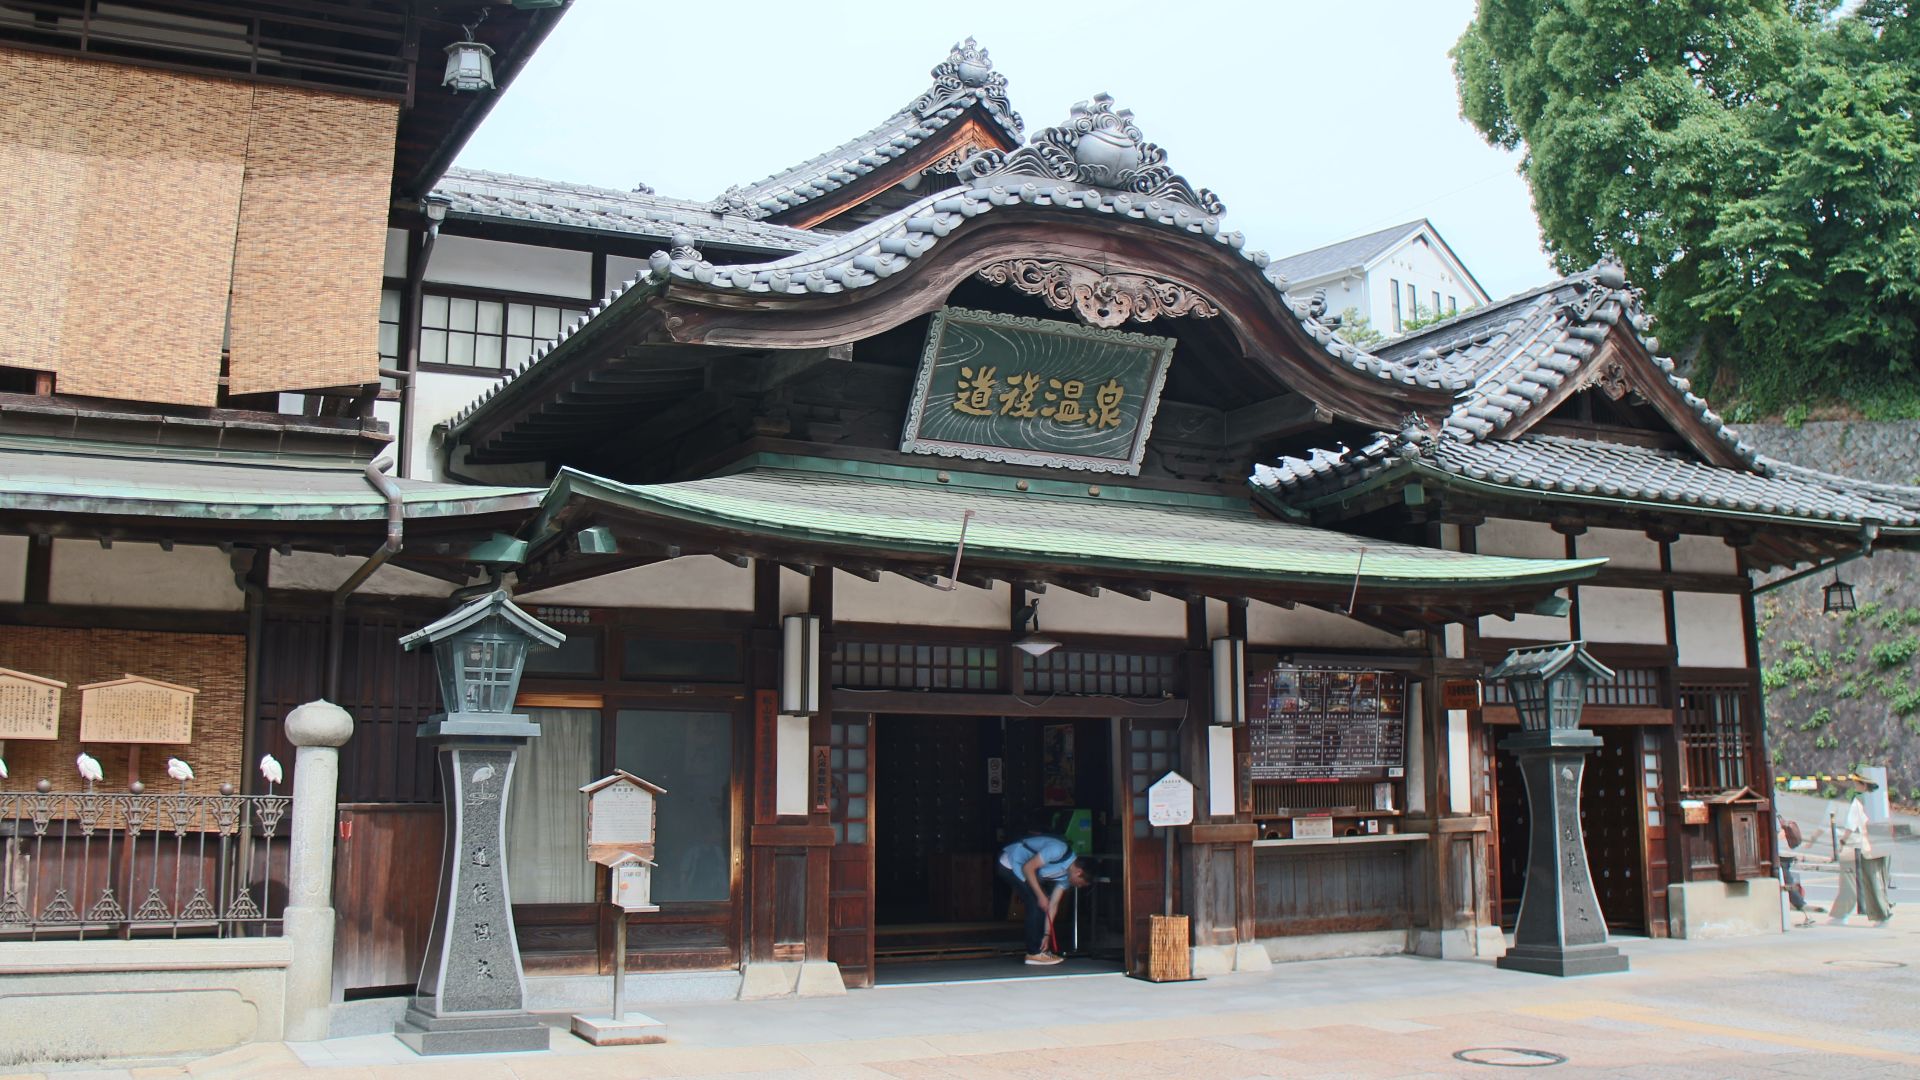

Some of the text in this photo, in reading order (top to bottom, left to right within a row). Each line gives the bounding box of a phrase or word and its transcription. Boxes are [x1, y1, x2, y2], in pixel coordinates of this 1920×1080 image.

[953, 366, 1124, 429] 道後温泉
[471, 846, 494, 980] 道後温泉
